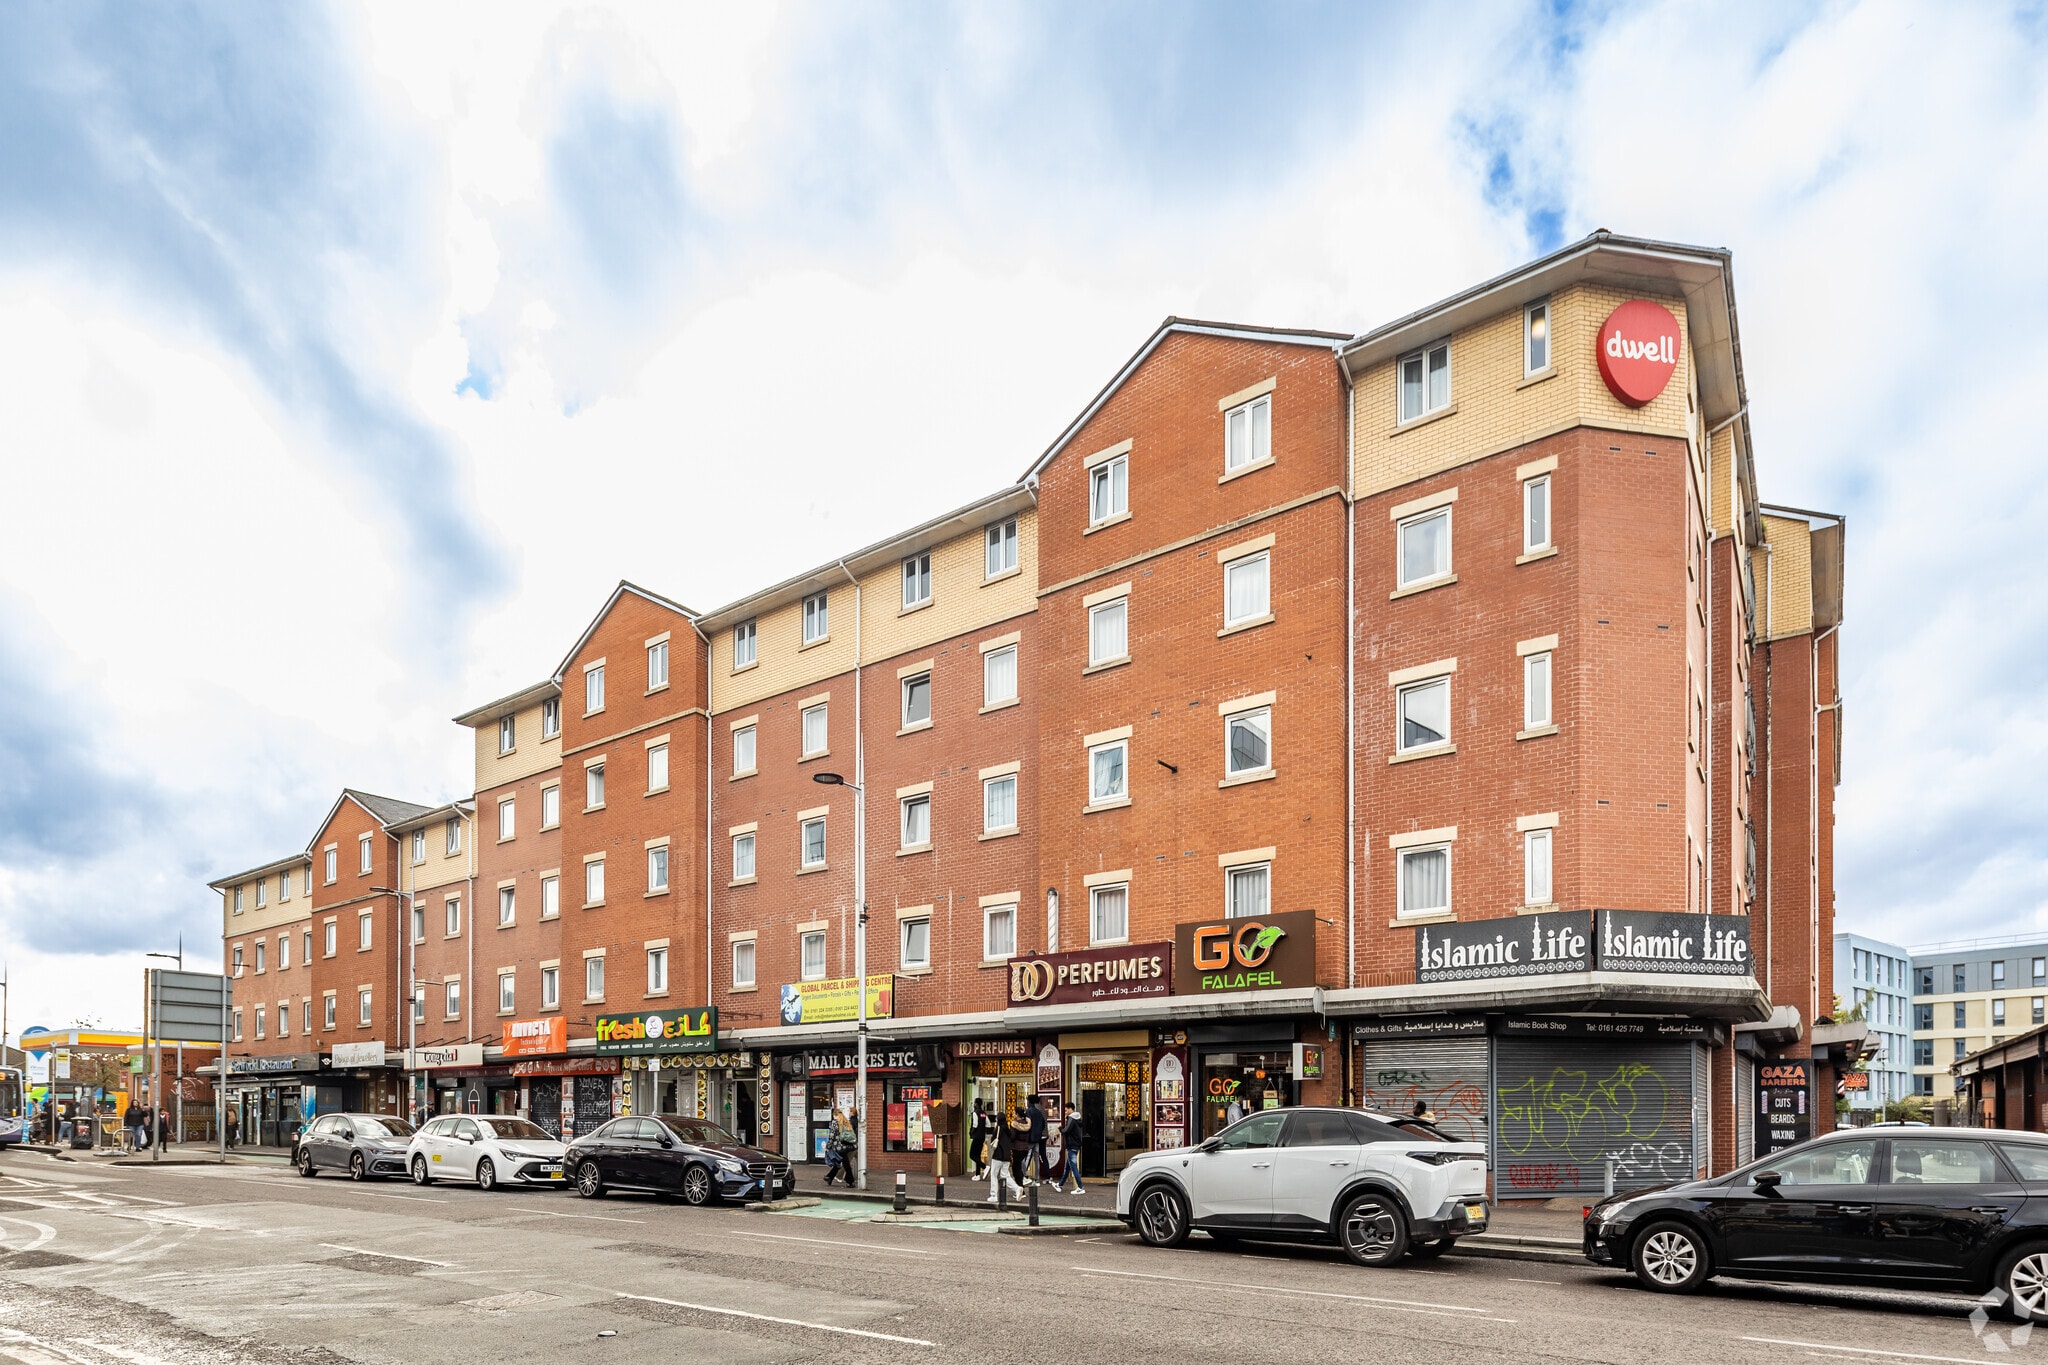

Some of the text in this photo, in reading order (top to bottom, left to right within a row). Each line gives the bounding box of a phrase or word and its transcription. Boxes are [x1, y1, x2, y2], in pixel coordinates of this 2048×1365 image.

[1607, 330, 1676, 364] dwell
[1603, 911, 1747, 962] Islamic Life
[1194, 922, 1272, 970] GO
[1420, 916, 1586, 970] Islamic Life
[1058, 956, 1163, 986] PERFUMES
[801, 984, 819, 993] GLOBAL
[821, 982, 839, 991] PARCEL
[846, 978, 870, 989] SHIPPG
[871, 976, 892, 986] CENTRE
[1202, 971, 1282, 989] FALAFEL
[596, 1017, 646, 1041] fresh
[1355, 1026, 1379, 1034] Clothes
[1387, 1024, 1402, 1032] Gifts
[1404, 1022, 1434, 1032] إسلامية
[1435, 1021, 1453, 1031] هدايا
[1460, 1020, 1485, 1030] ملابس
[1508, 1020, 1567, 1031] Islamic Book Shop
[1586, 1024, 1644, 1033] Tel: 0161 425 7749
[1658, 1023, 1704, 1035] مكتبة إسلامية
[974, 1041, 1026, 1055] PERFUMES
[808, 1055, 841, 1069] MAIL
[888, 1051, 917, 1067] ETC.
[1761, 1066, 1805, 1078] GAZA
[1209, 1077, 1236, 1095] GO
[1760, 1078, 1806, 1086] BARBERS
[906, 1089, 928, 1099] TAPE
[1206, 1095, 1239, 1103] FALAFEL
[1775, 1098, 1791, 1108] CUTS
[1771, 1114, 1795, 1124] BEARDS
[1771, 1130, 1795, 1140] WAXING
